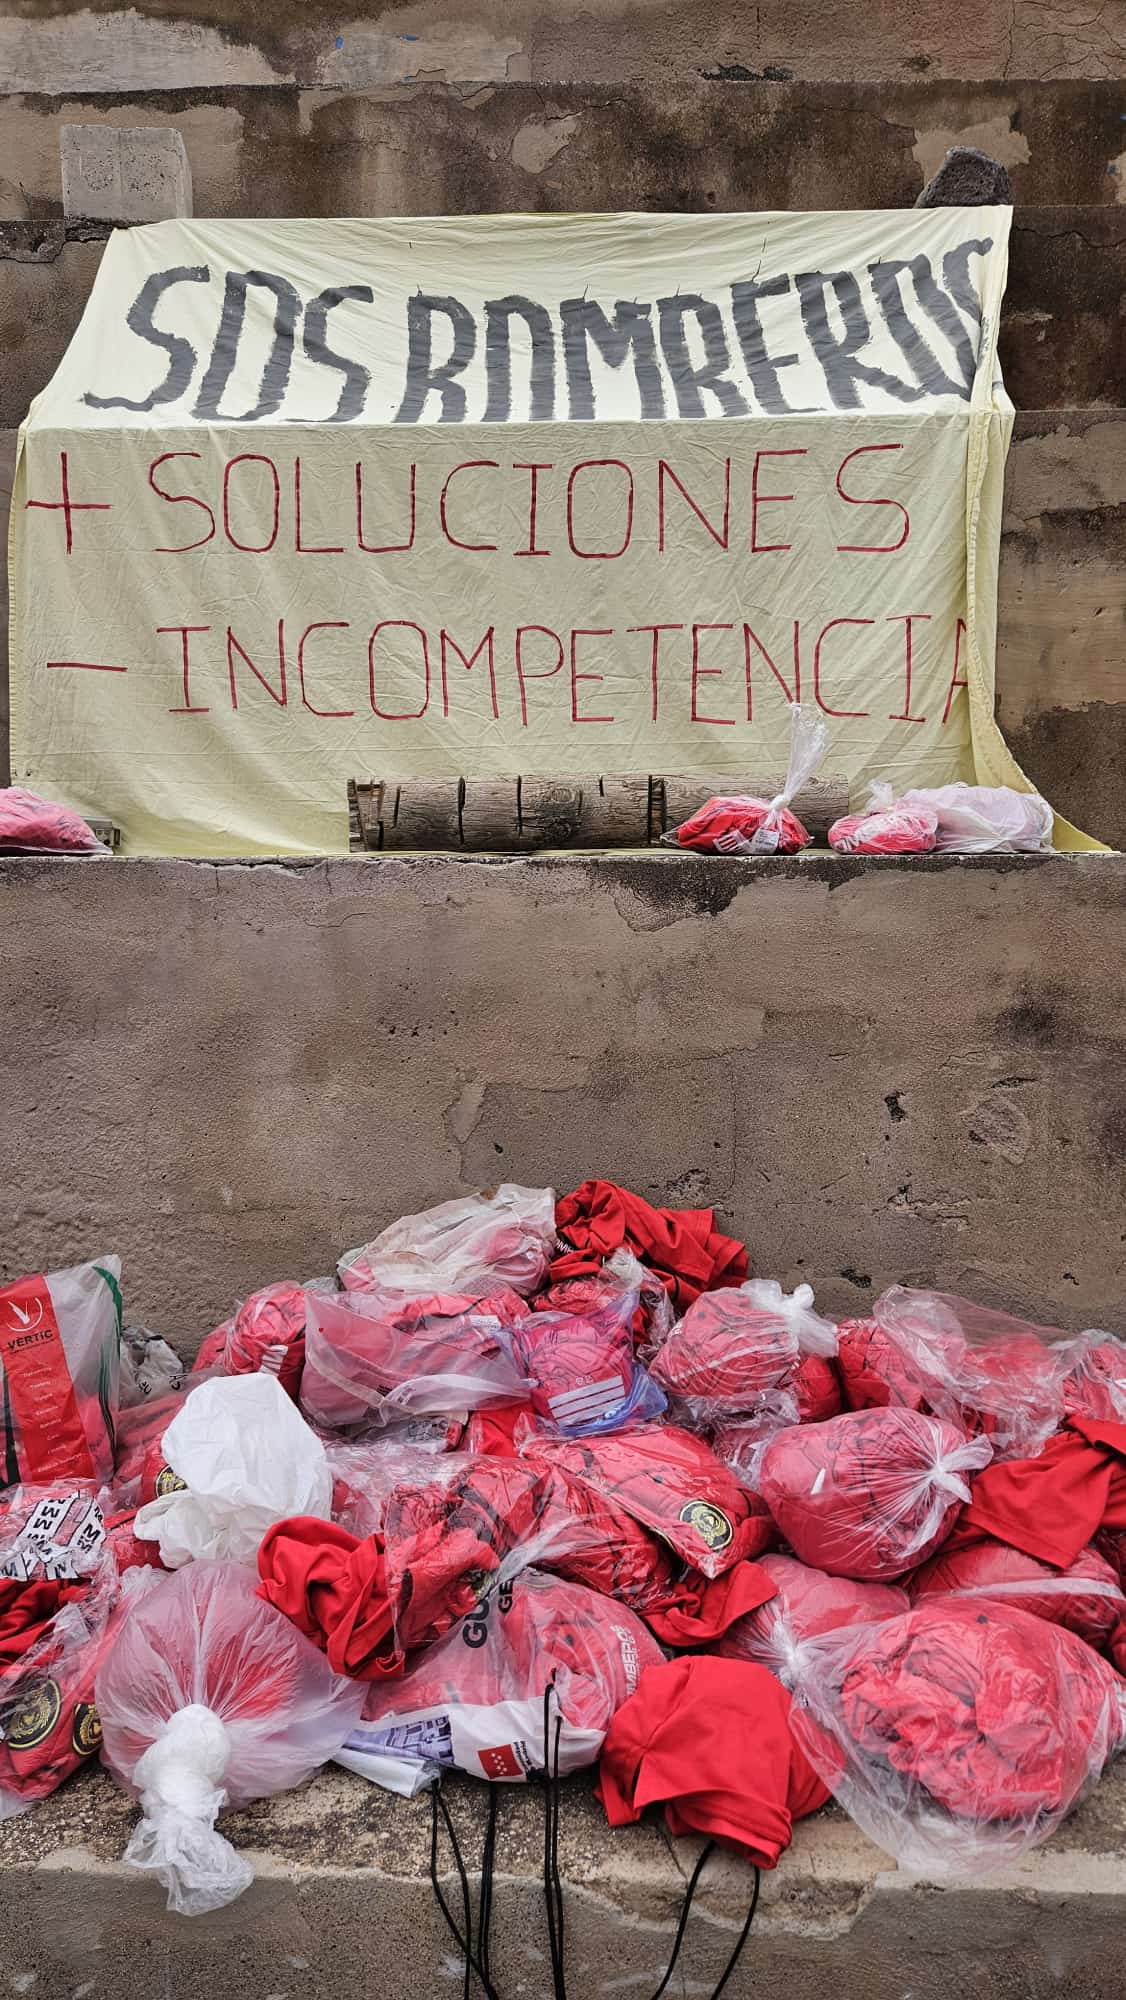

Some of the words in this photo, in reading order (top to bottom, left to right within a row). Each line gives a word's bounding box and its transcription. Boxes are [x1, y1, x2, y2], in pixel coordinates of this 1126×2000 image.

[83, 265, 374, 423] SOS
[391, 237, 994, 423] BOMBEROS
[147, 443, 910, 559] SOLUCIONES
